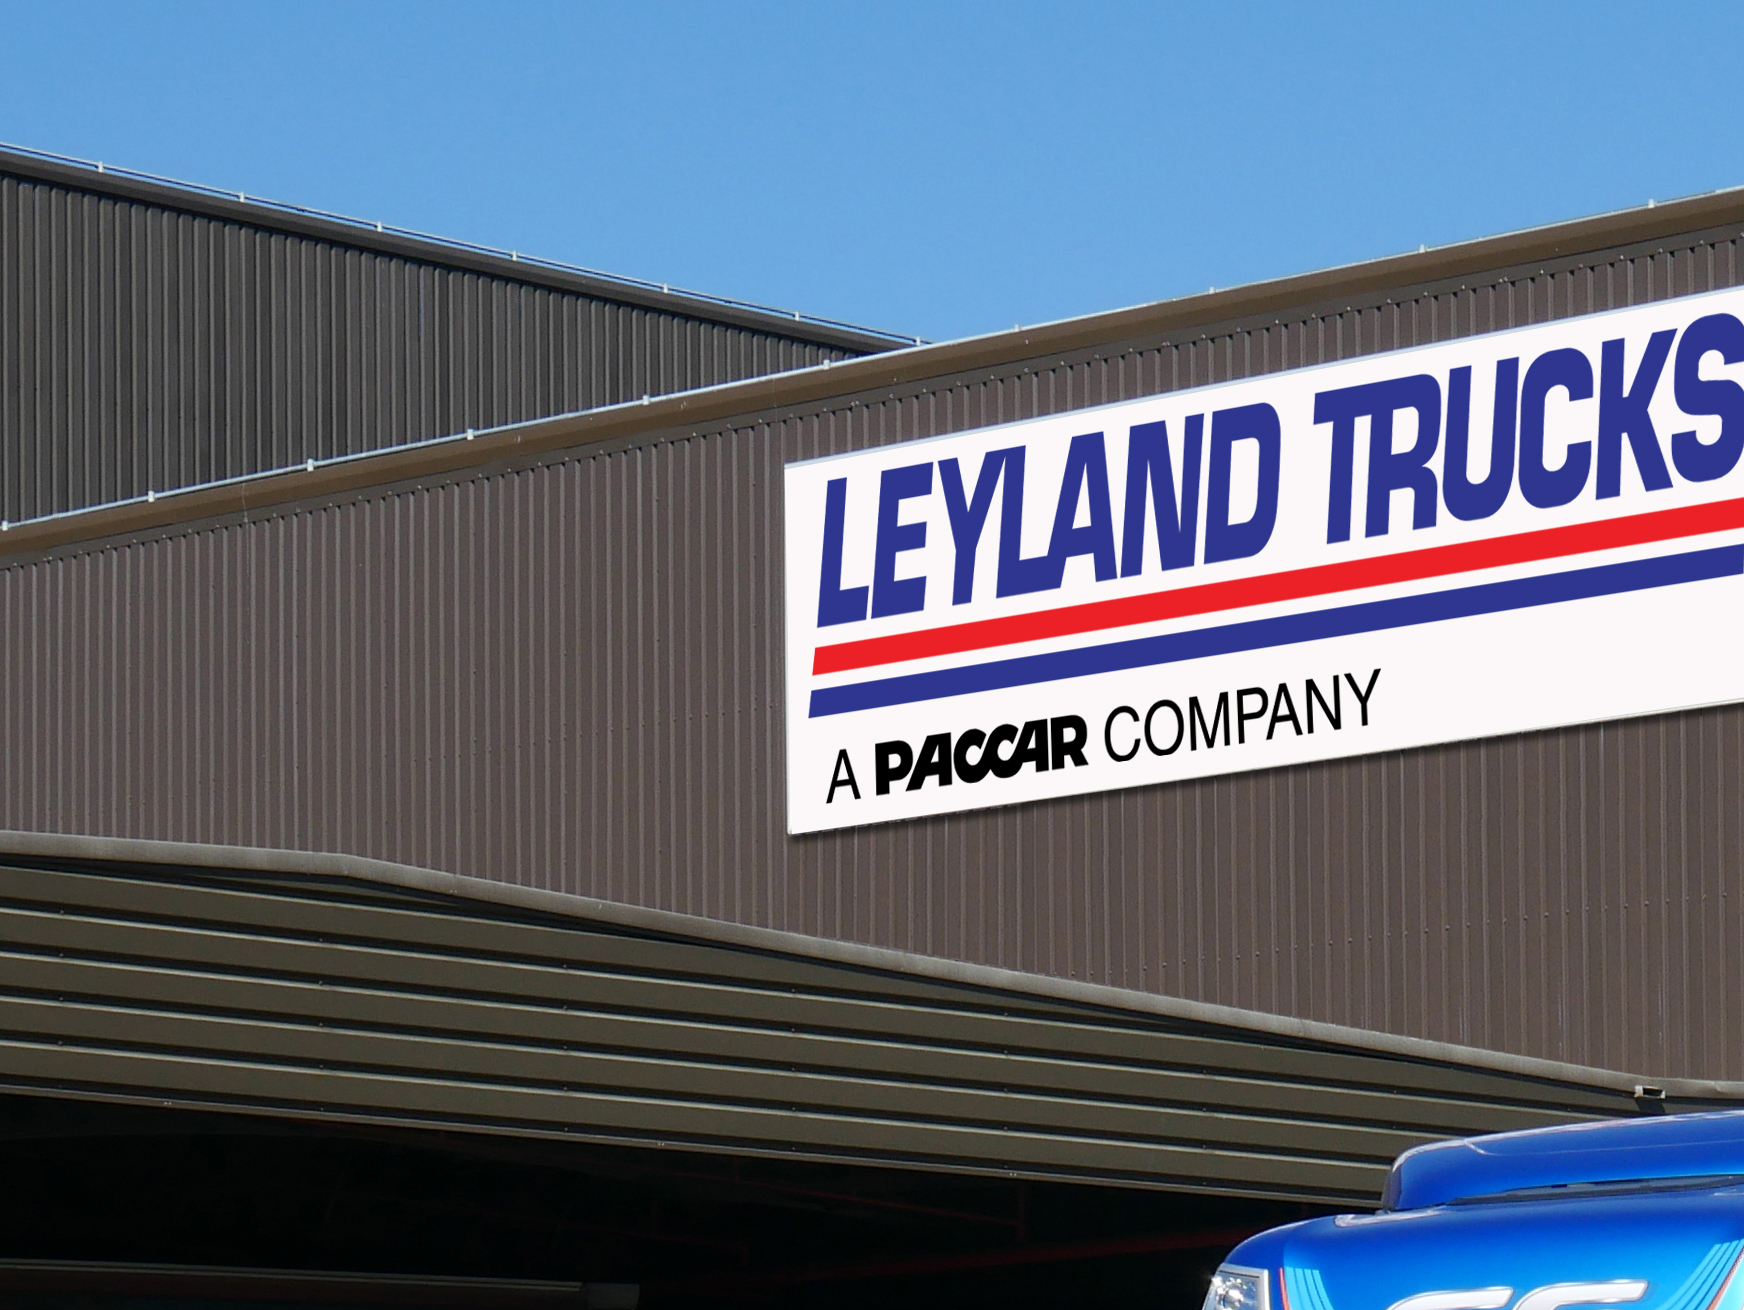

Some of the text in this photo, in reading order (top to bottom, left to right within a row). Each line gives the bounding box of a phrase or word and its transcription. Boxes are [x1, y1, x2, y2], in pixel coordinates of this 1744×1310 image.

[816, 402, 1281, 628] LEYLAND
[825, 668, 1382, 804] A PACCAR COMPANY
